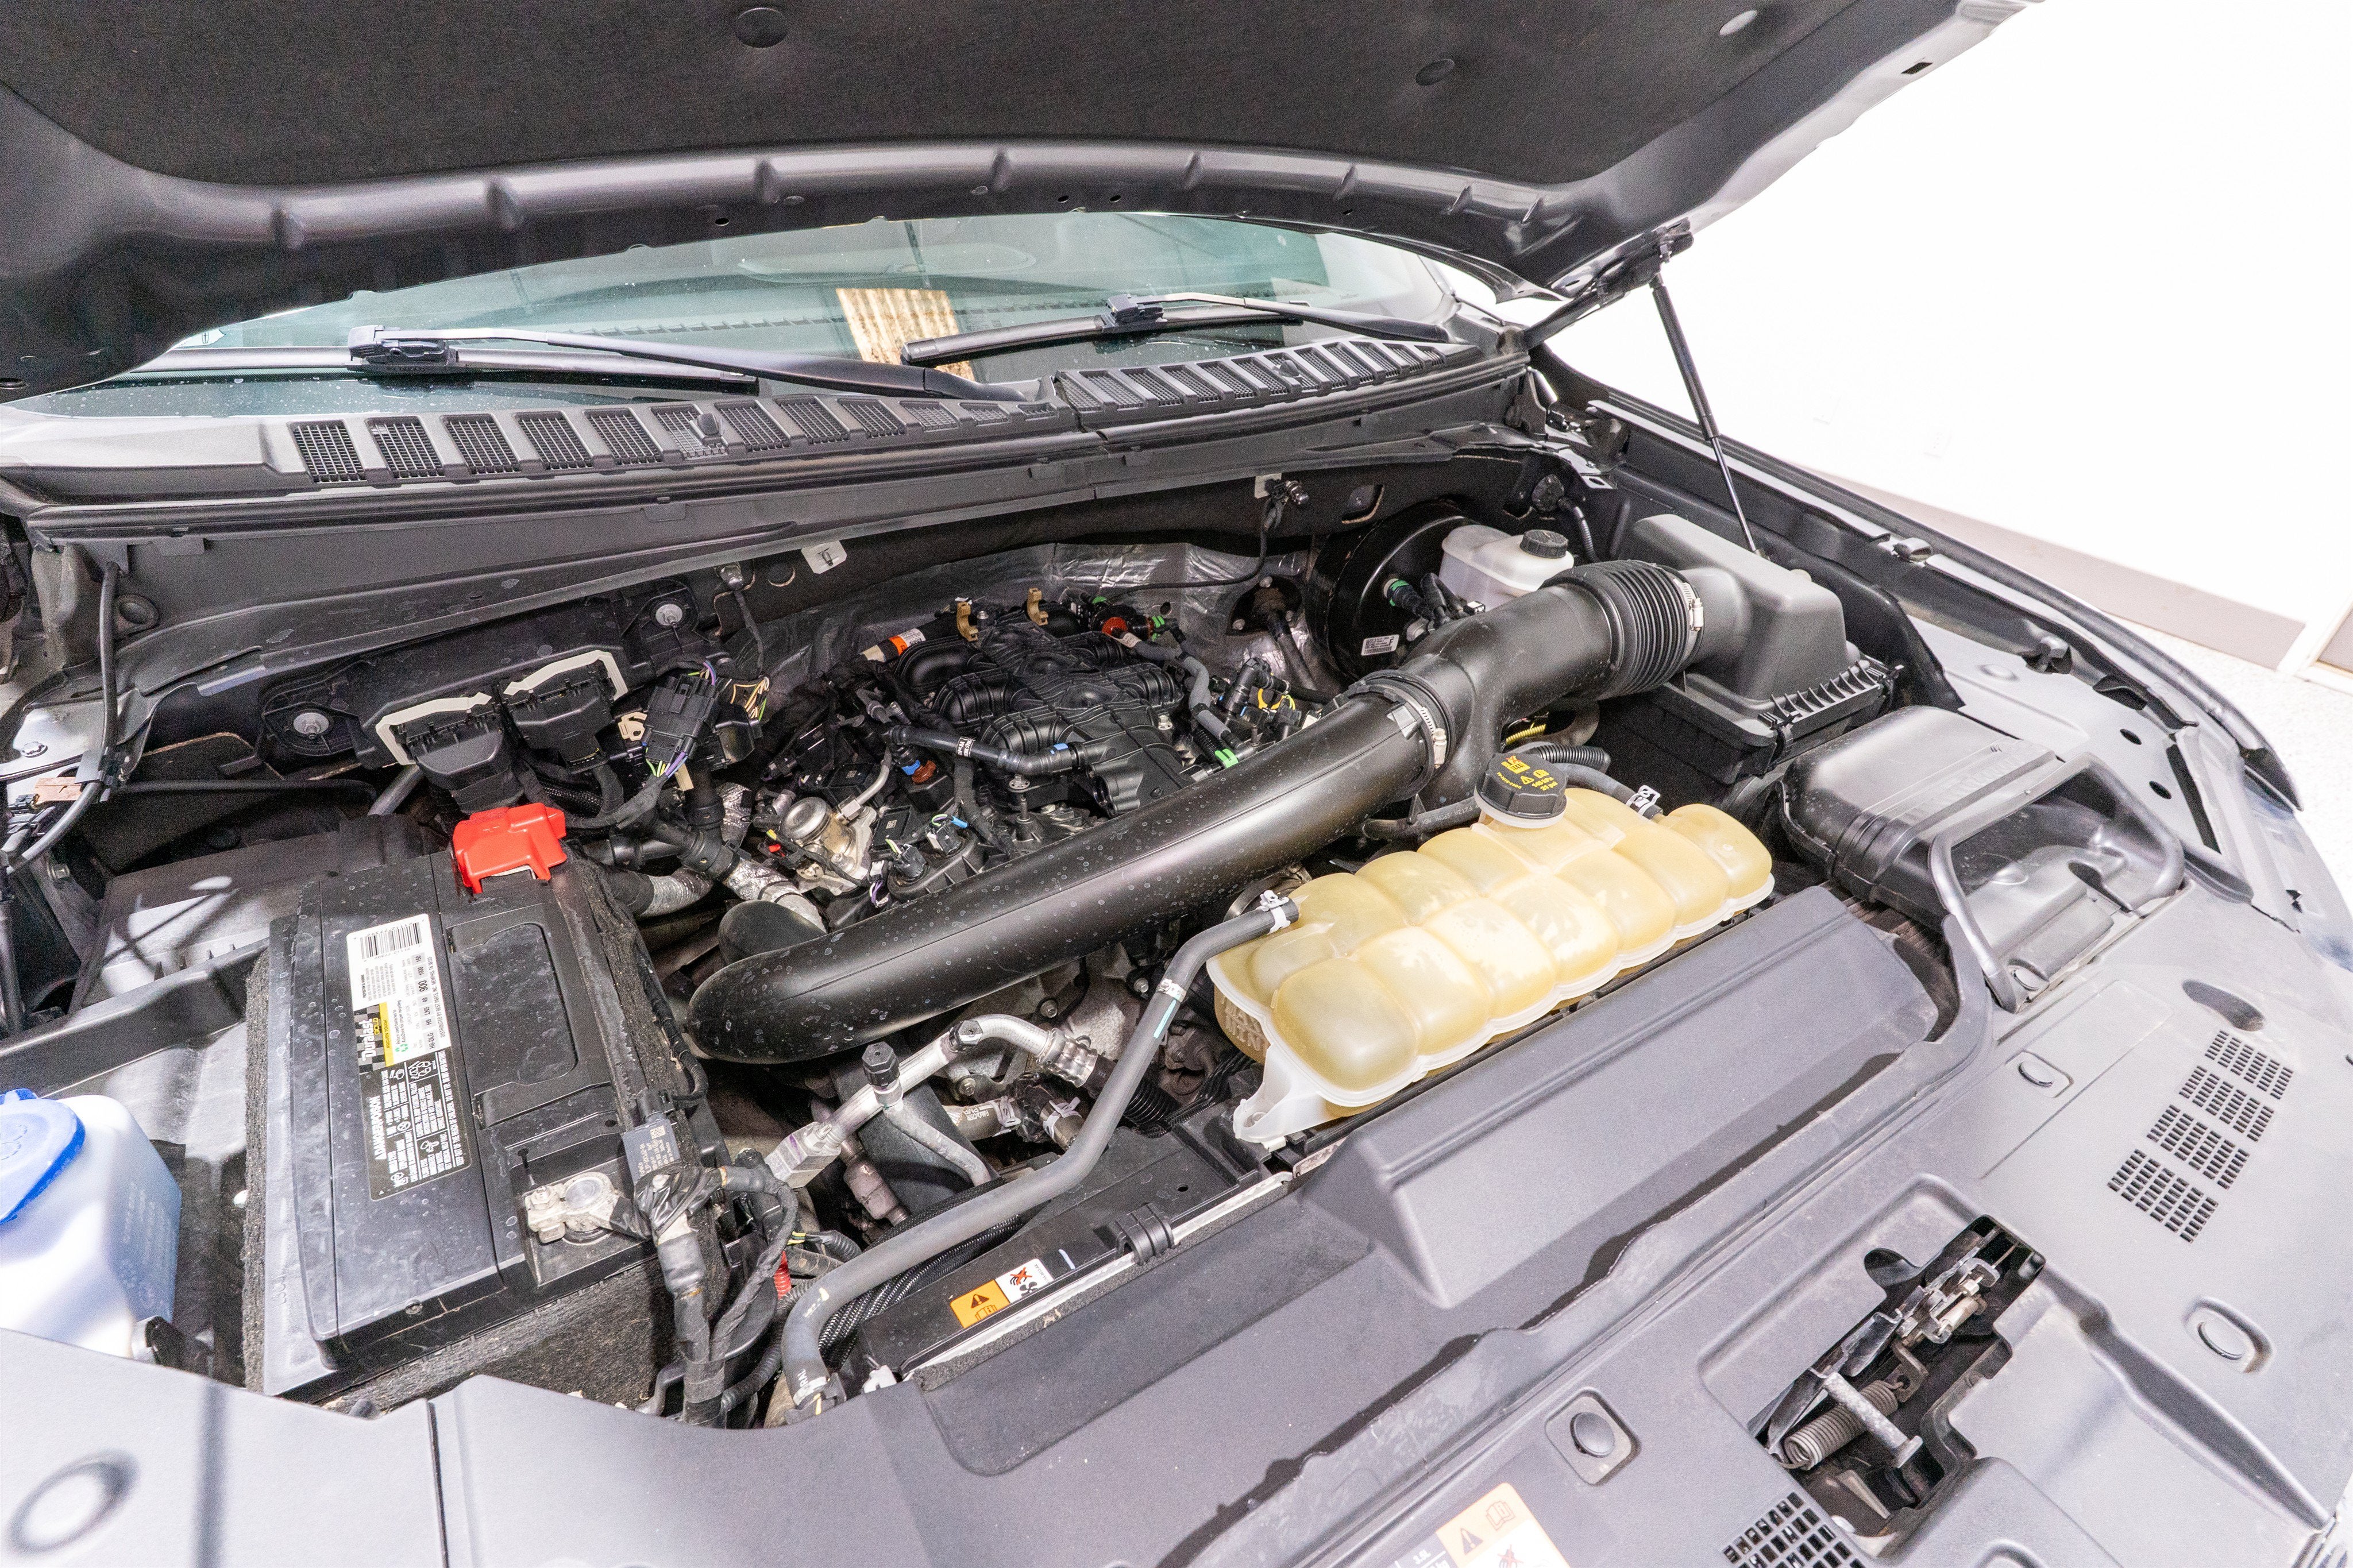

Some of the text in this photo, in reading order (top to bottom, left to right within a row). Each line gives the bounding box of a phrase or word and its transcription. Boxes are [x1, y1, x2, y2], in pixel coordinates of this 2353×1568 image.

[418, 979, 429, 992] 900
[372, 1016, 380, 1036] GOLD
[437, 1015, 446, 1038] DISTRIBUTED
[1225, 1015, 1262, 1052] MIN
[358, 1017, 377, 1061] Duralast
[427, 1032, 435, 1049] H8-DLG
